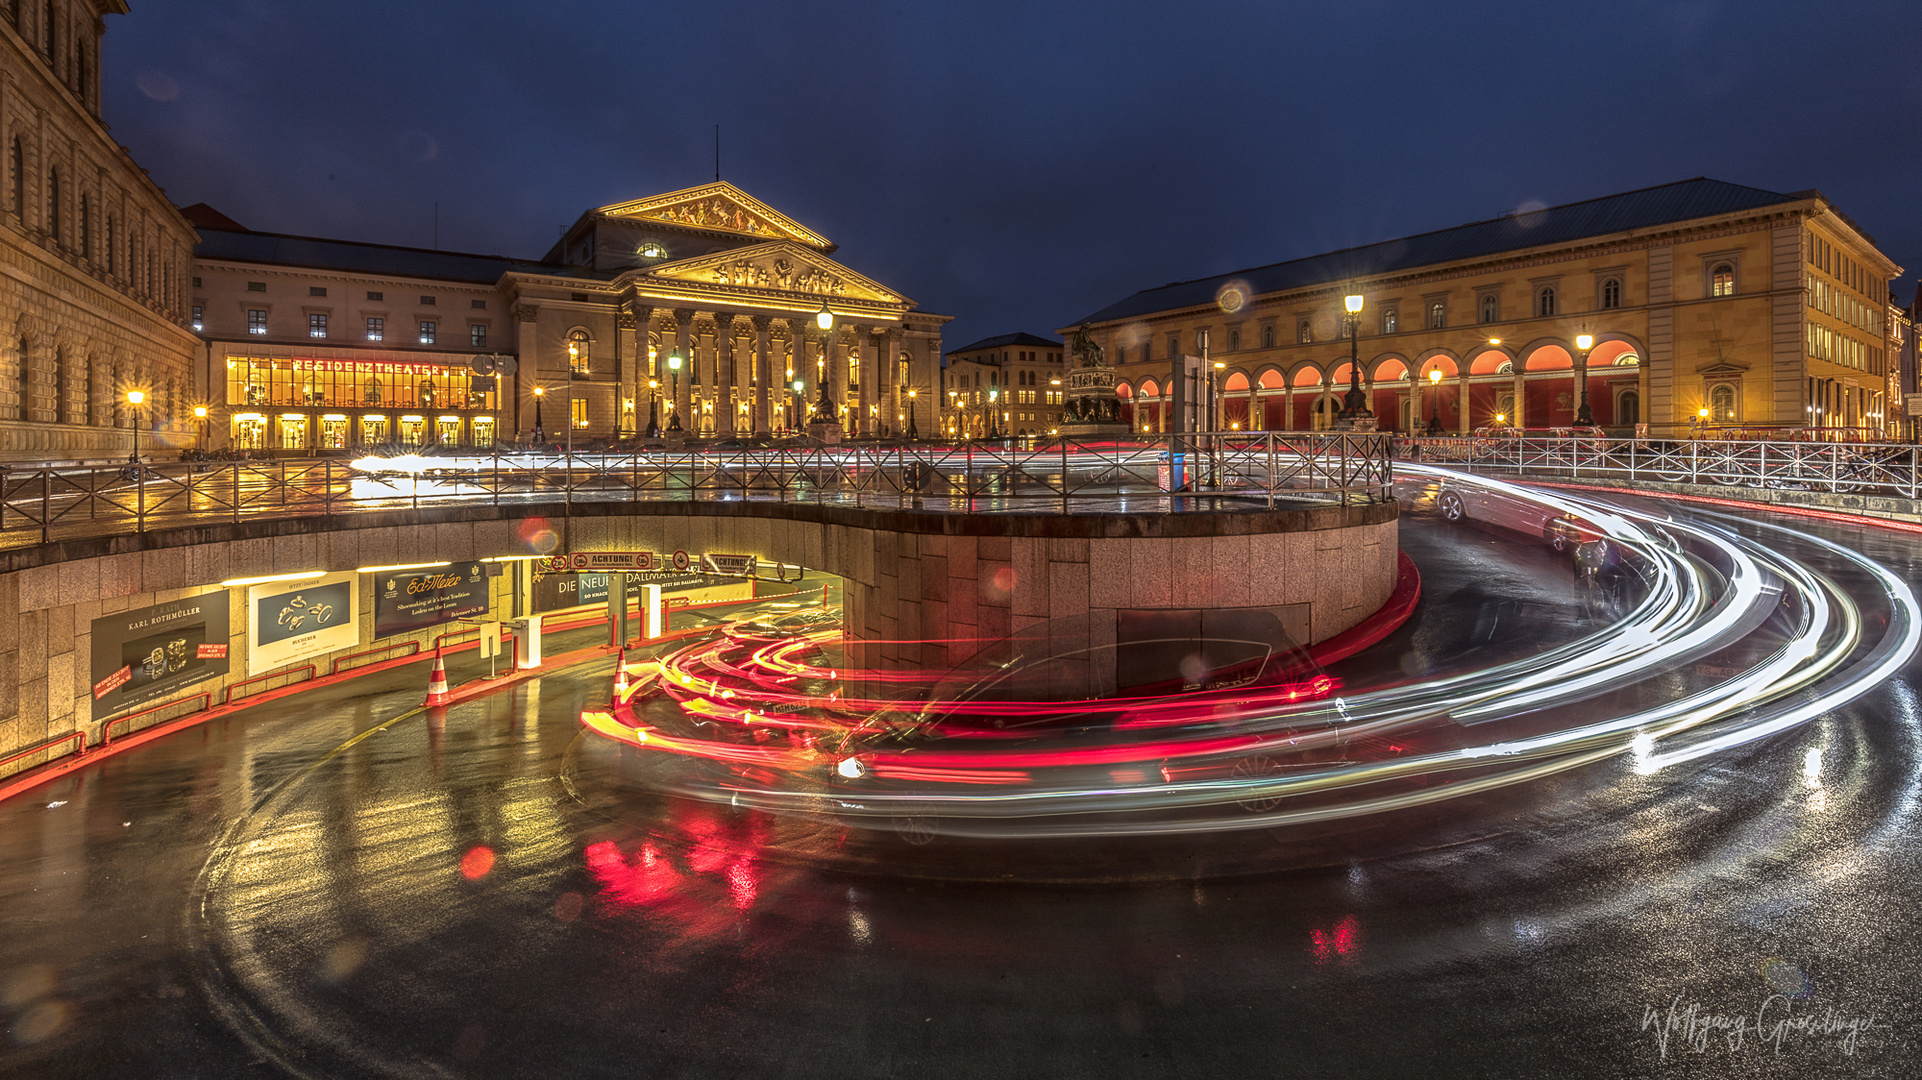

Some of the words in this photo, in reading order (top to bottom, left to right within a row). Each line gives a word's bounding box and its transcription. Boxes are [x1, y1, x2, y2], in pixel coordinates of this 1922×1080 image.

[294, 360, 439, 375] RESIDENZTHEATER
[592, 555, 633, 563] ACHTUNG!
[715, 557, 746, 567] ACHTUNG!
[558, 580, 576, 593] DIE
[397, 600, 427, 611] Shoemaking
[450, 591, 471, 600] Tradition
[411, 608, 428, 616] Loden
[128, 620, 149, 631] KARL
[151, 607, 201, 625] ROTHMÜLLER
